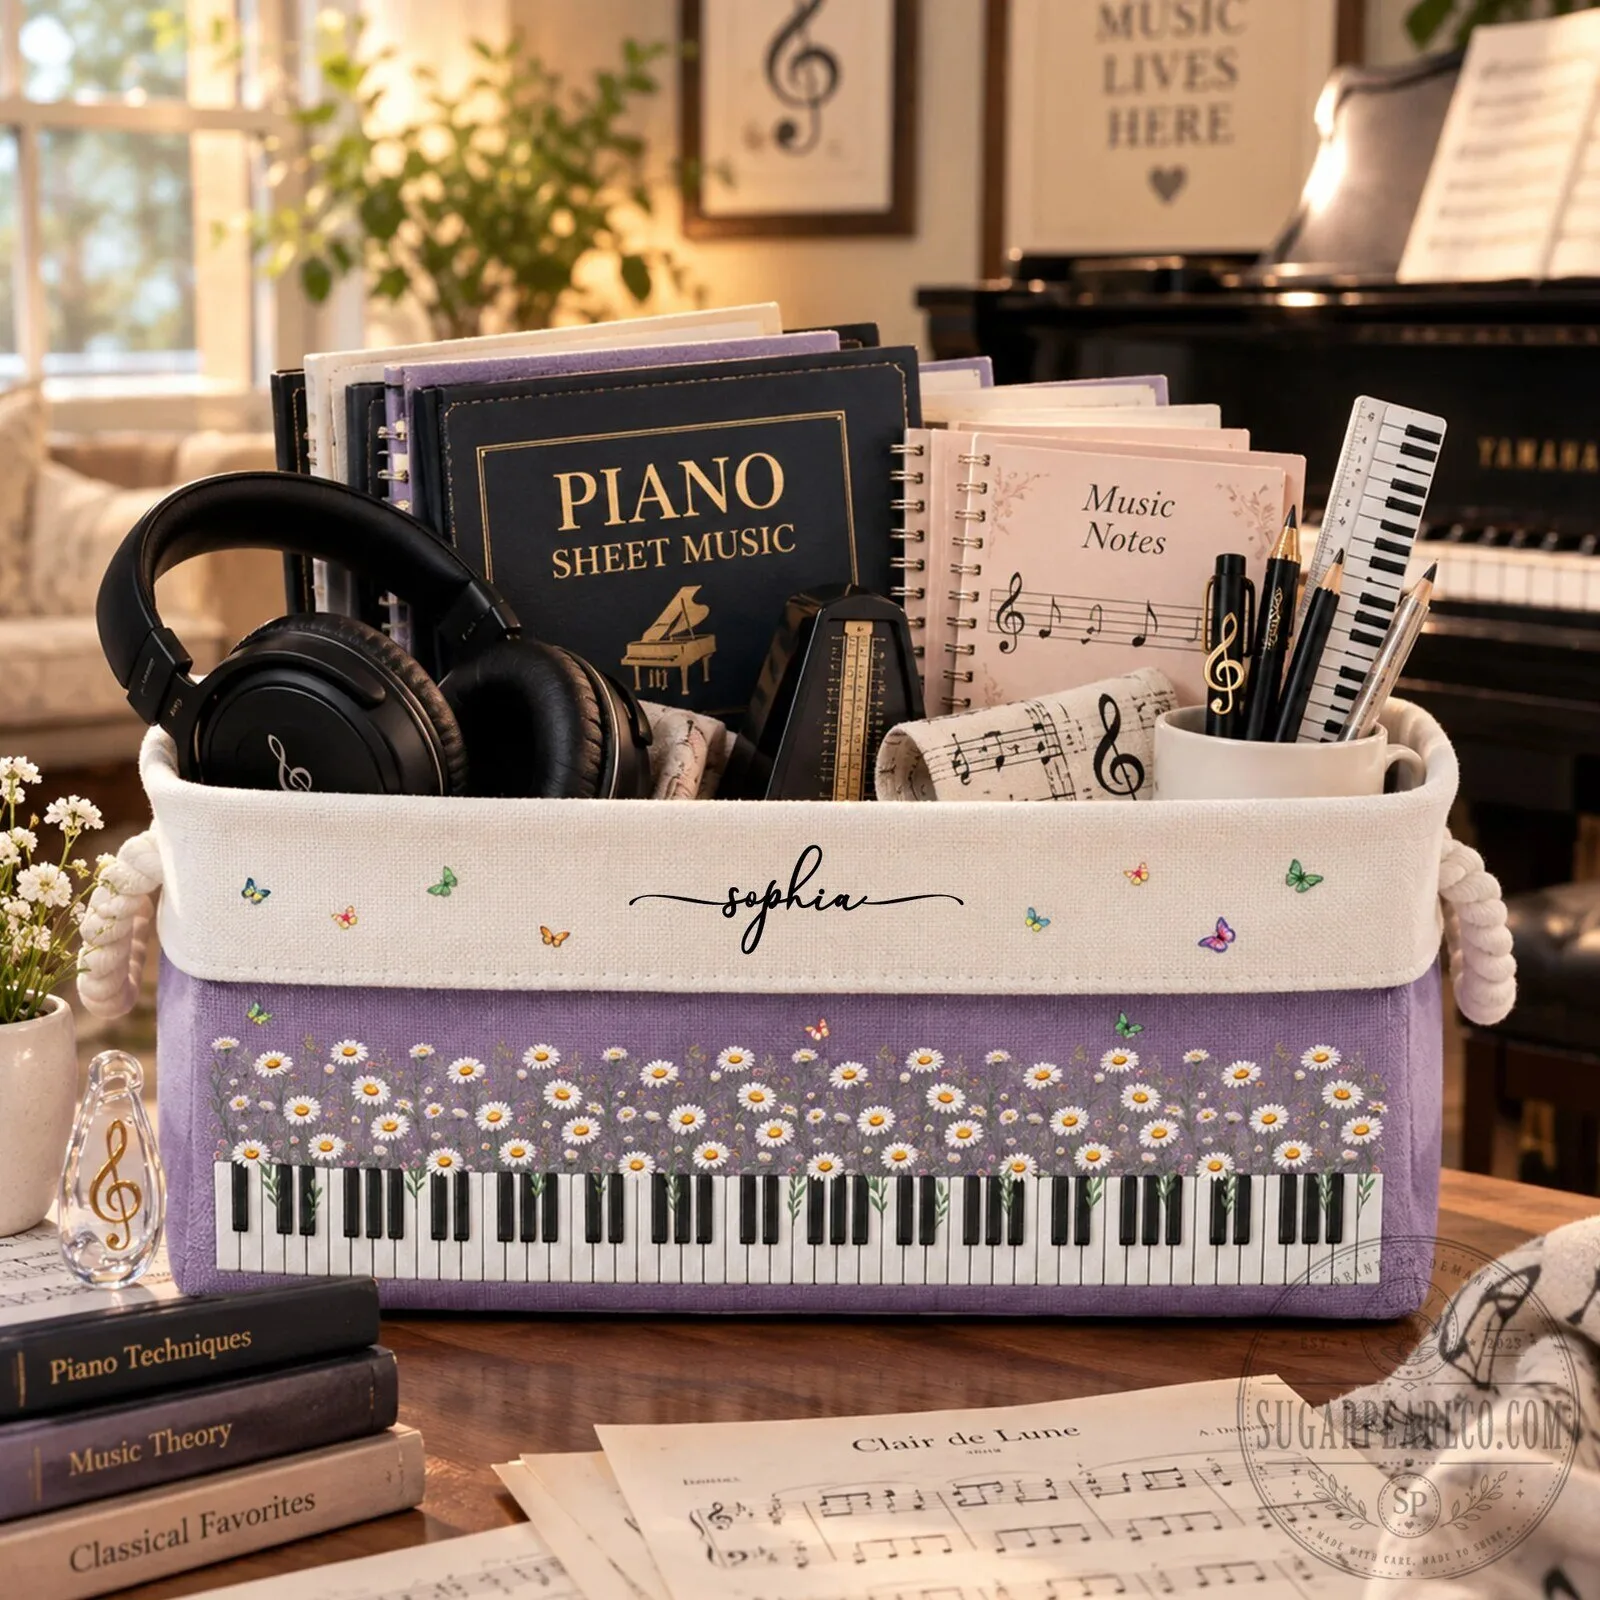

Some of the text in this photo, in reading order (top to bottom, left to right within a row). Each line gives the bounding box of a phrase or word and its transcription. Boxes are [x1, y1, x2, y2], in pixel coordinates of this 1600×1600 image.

[1096, 0, 1248, 42] MUSIC
[1102, 46, 1239, 95] LIVES
[1108, 102, 1236, 149] HERE
[1478, 436, 1599, 472] YAMAHA
[553, 452, 785, 531] PIANO
[1081, 483, 1175, 518] Music
[552, 523, 796, 579] SHEET MUSIC
[1081, 521, 1167, 555] Notes
[50, 1329, 253, 1385] Piano Techniques
[69, 1423, 233, 1477] Music Theory
[852, 1425, 1081, 1453] Clair de Lune
[70, 1492, 316, 1574] Classical Favorites
